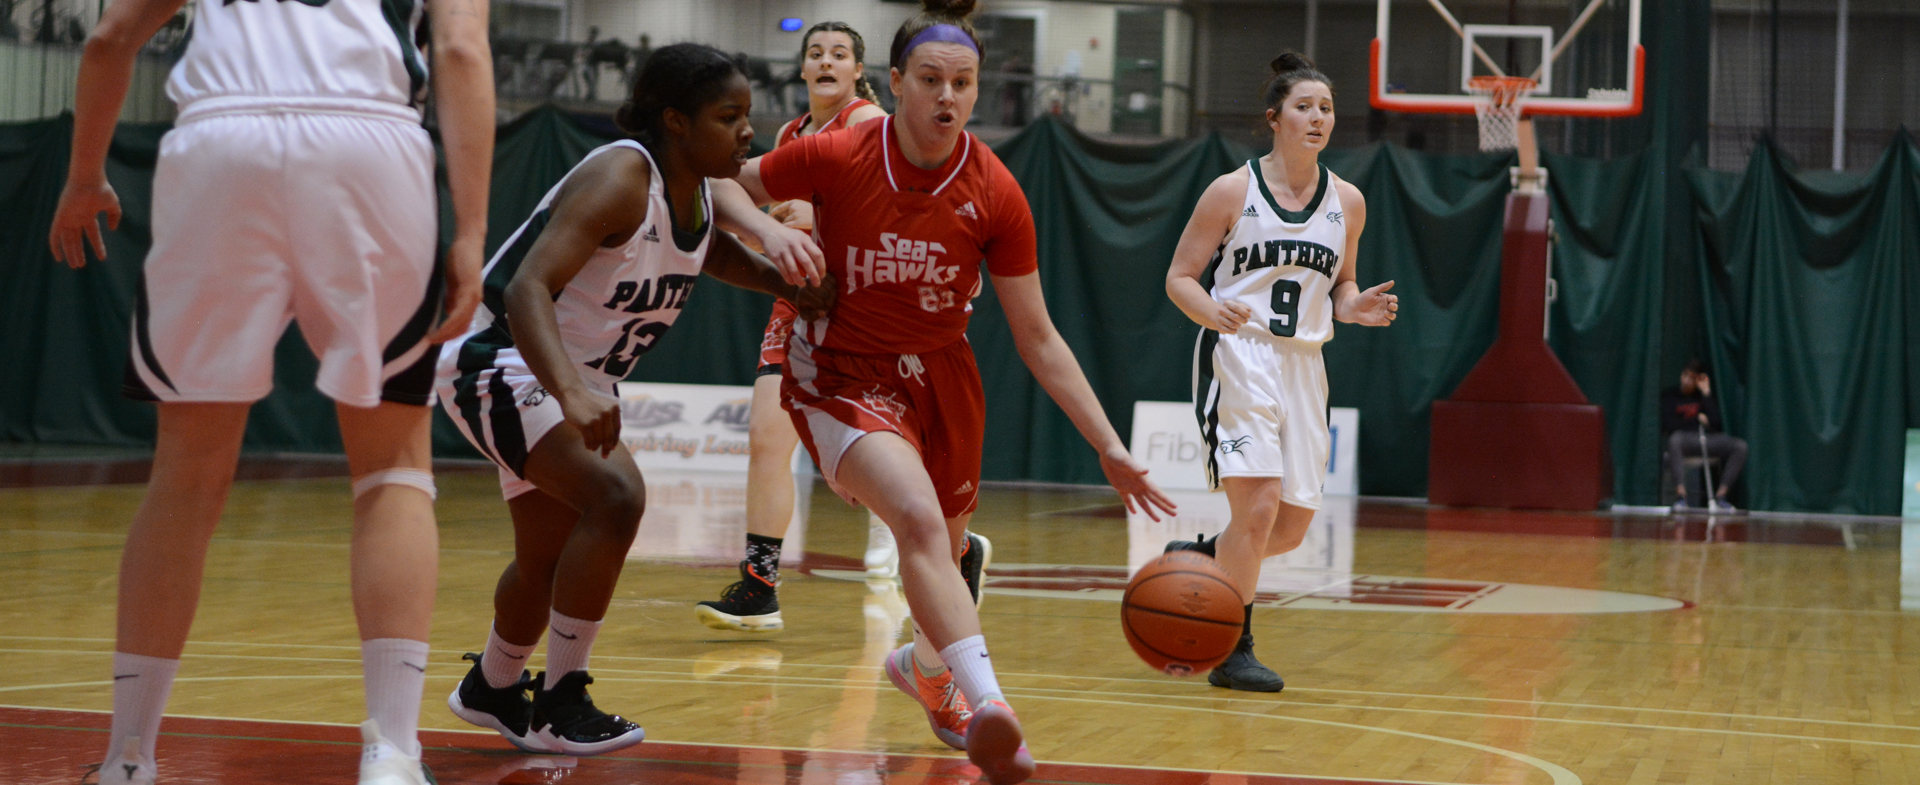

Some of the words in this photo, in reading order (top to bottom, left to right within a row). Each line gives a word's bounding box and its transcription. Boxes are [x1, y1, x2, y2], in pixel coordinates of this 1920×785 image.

[603, 274, 699, 313] PANTH
[846, 245, 960, 295] Hawks
[1269, 279, 1301, 338] 9
[583, 318, 672, 378] 13
